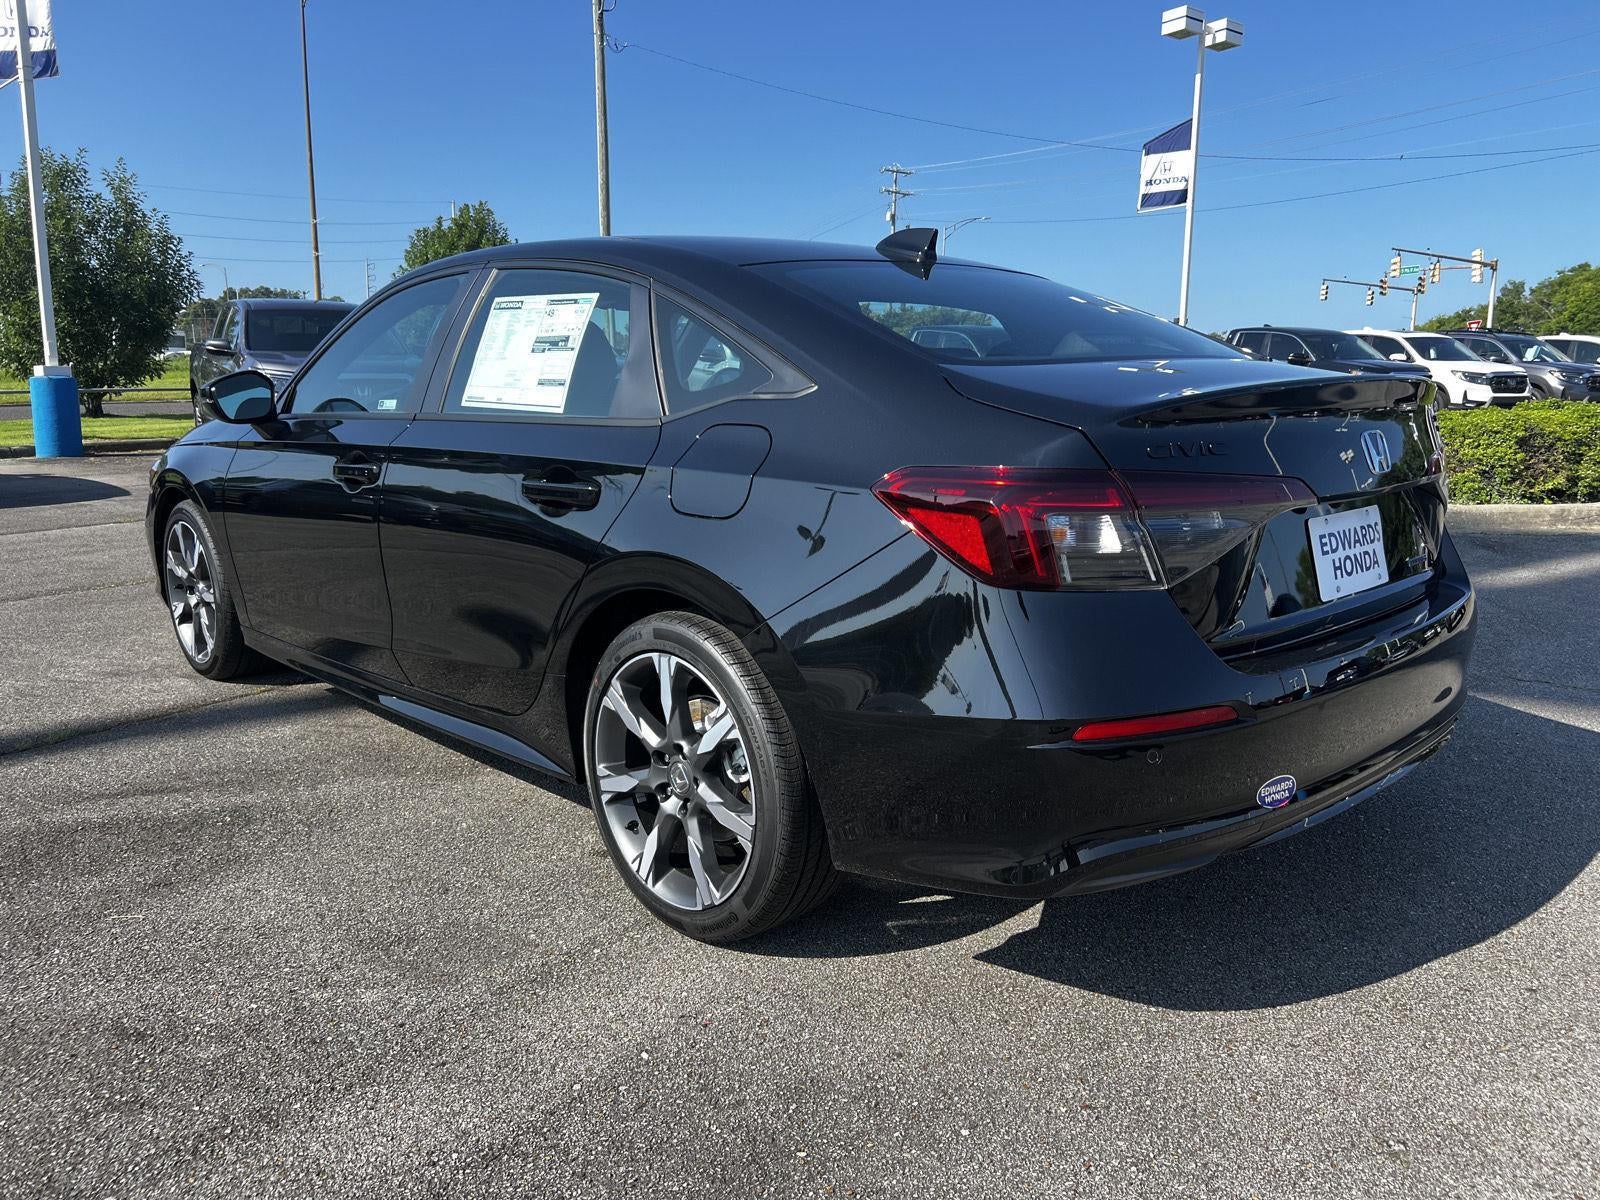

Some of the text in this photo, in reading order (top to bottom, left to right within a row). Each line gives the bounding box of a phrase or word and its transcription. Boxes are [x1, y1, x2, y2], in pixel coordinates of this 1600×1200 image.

[1145, 176, 1188, 187] HONDA
[500, 301, 523, 310] HONDA
[1146, 441, 1228, 459] CIVIC
[1318, 522, 1381, 557] EDWARDS
[1332, 549, 1380, 580] HONDA
[1261, 780, 1293, 797] EDWARDS
[1265, 790, 1289, 804] HONDA
